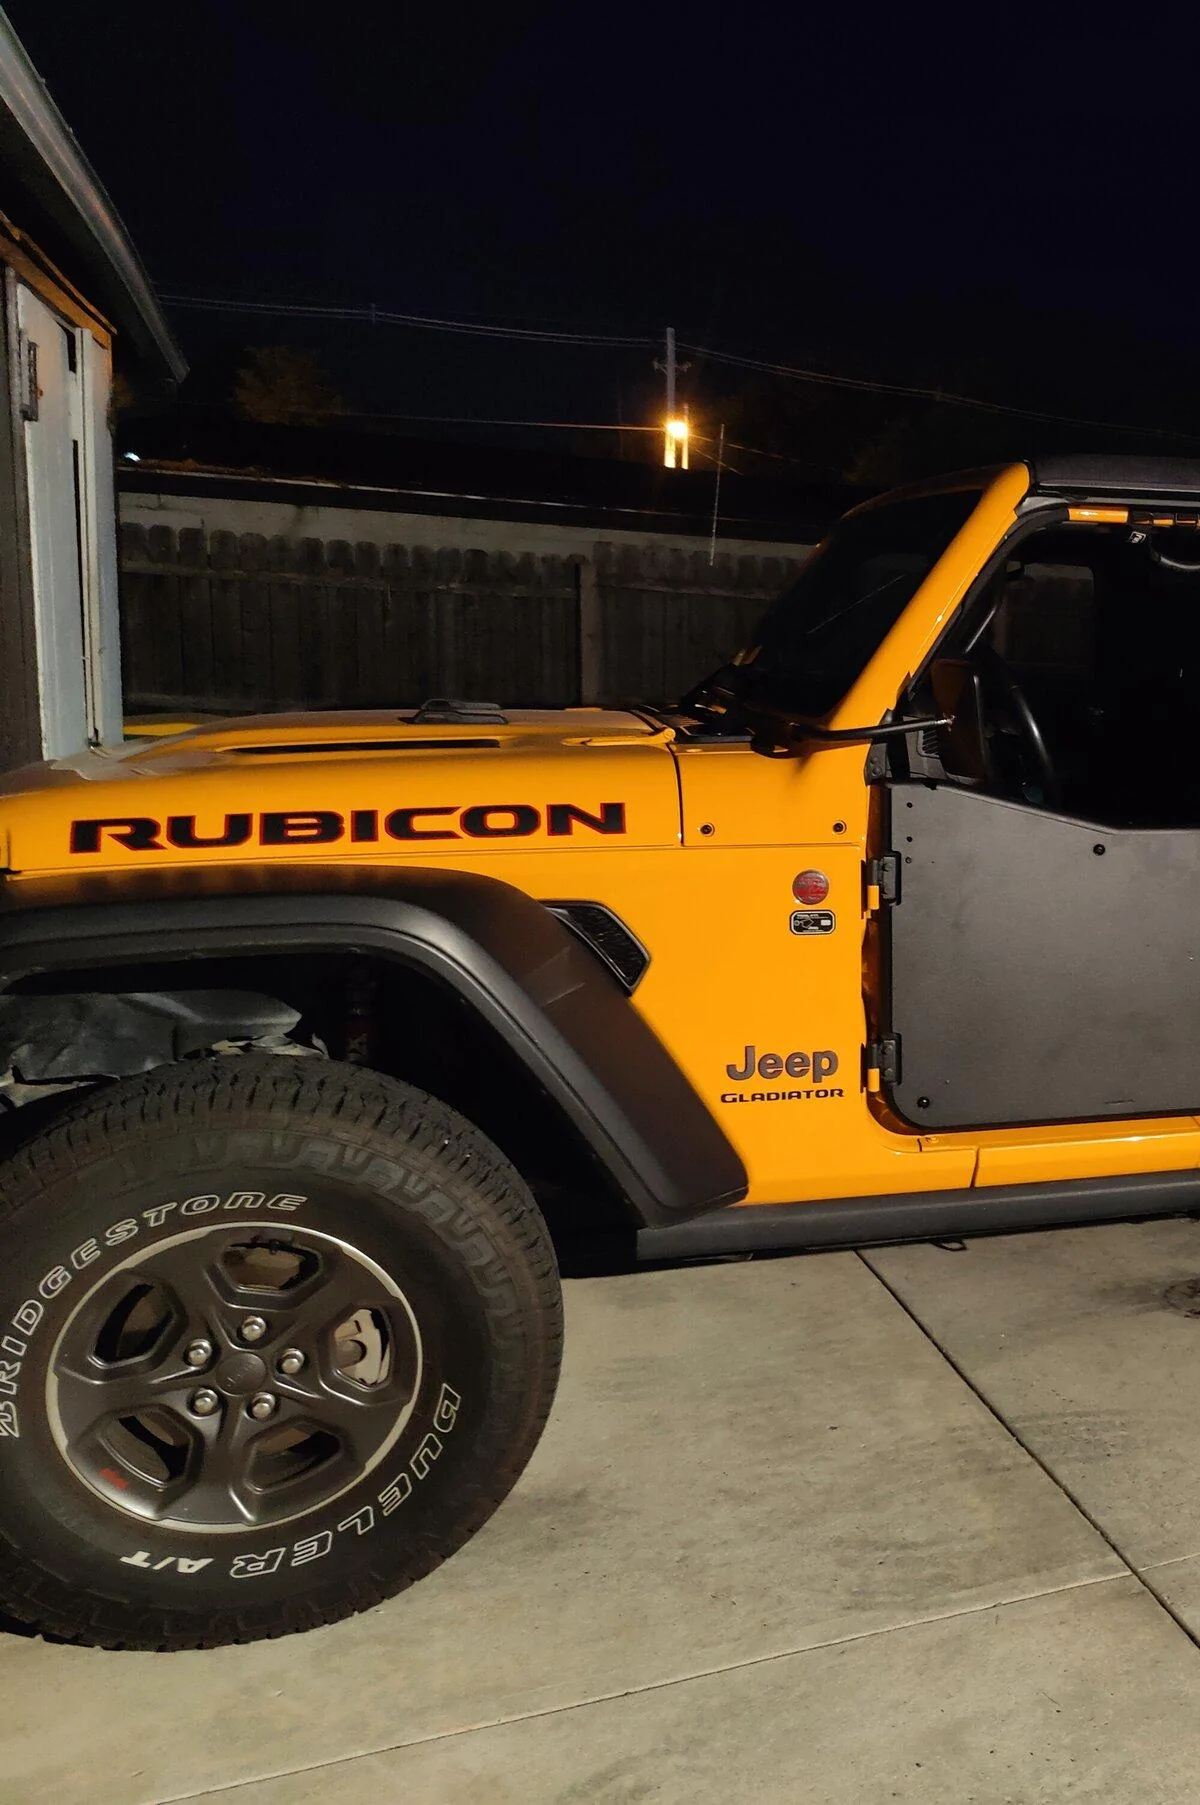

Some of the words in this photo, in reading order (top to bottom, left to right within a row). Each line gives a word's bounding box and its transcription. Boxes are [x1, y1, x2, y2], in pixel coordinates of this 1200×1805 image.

[69, 802, 627, 854] RUBICON
[726, 1045, 839, 1083] Jeep
[720, 1088, 845, 1104] GLADIATOR
[0, 1191, 308, 1438] BRIDGESTONE
[229, 1383, 462, 1578] DUELER
[120, 1548, 215, 1575] A/T
